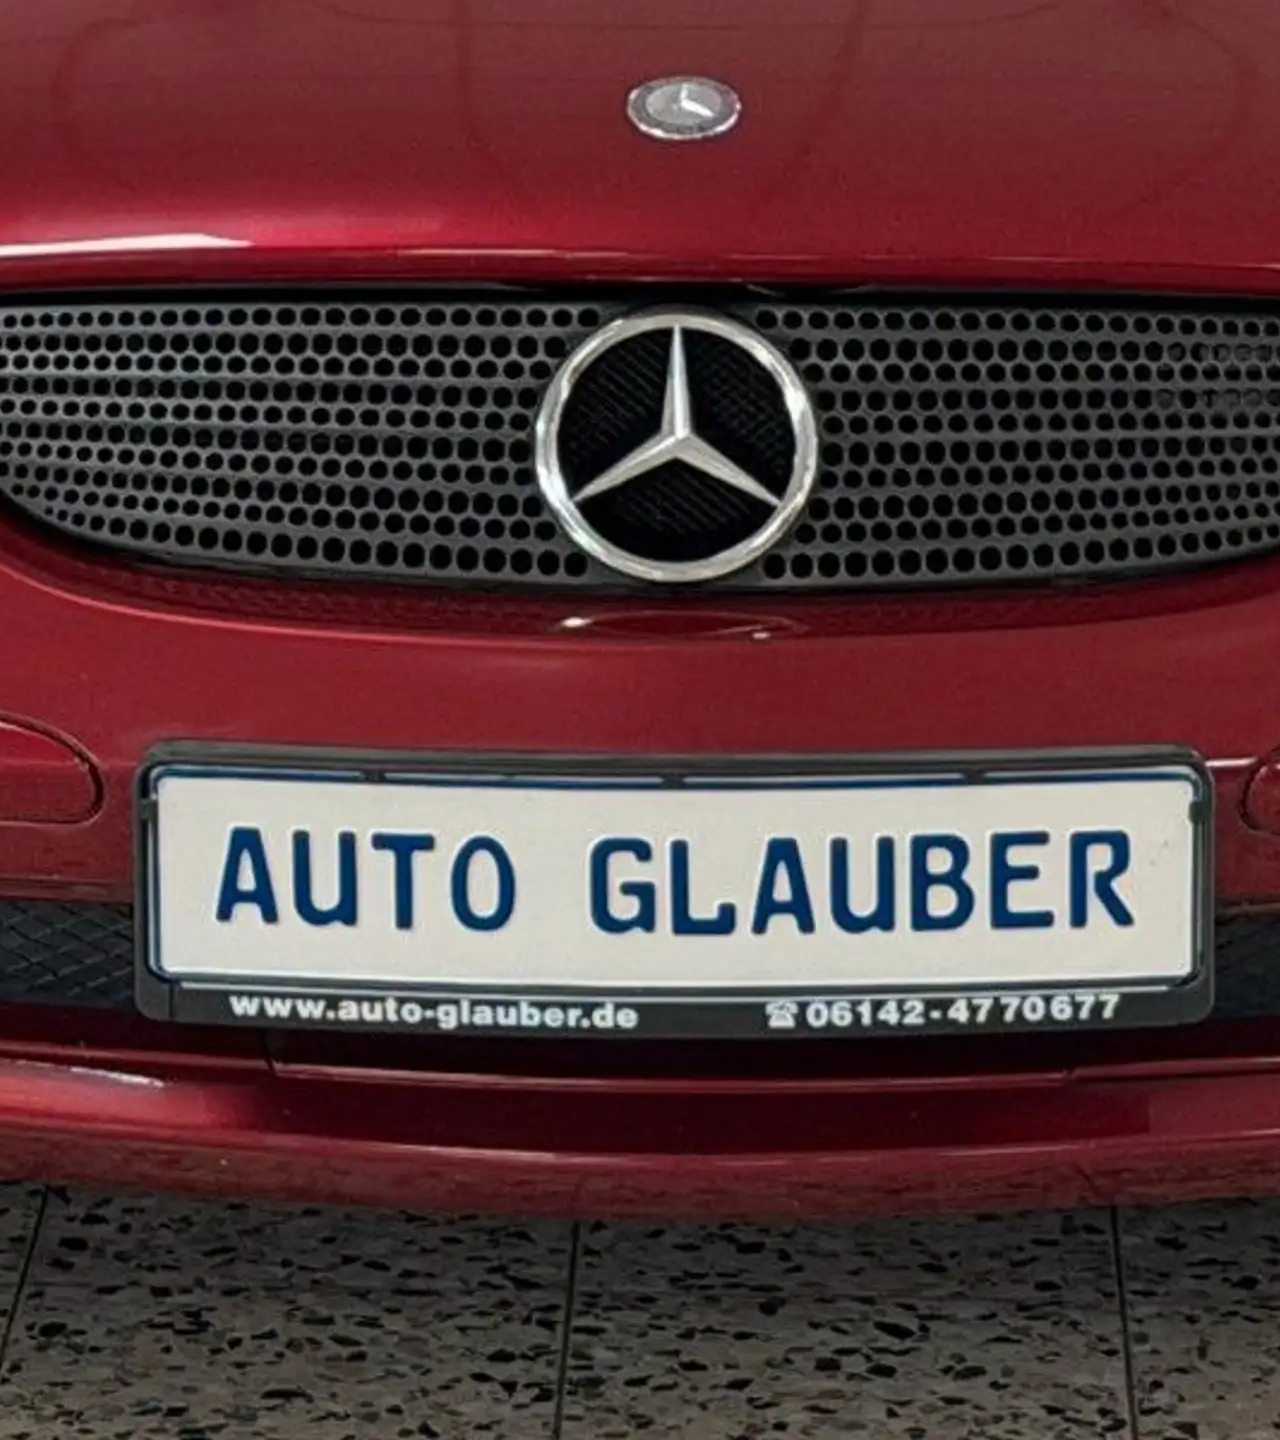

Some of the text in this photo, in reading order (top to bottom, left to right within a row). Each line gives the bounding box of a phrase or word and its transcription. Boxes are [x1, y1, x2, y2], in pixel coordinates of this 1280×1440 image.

[216, 826, 1135, 936] AUTO GLAUBER
[229, 994, 638, 1029] www.auto-glauber.de
